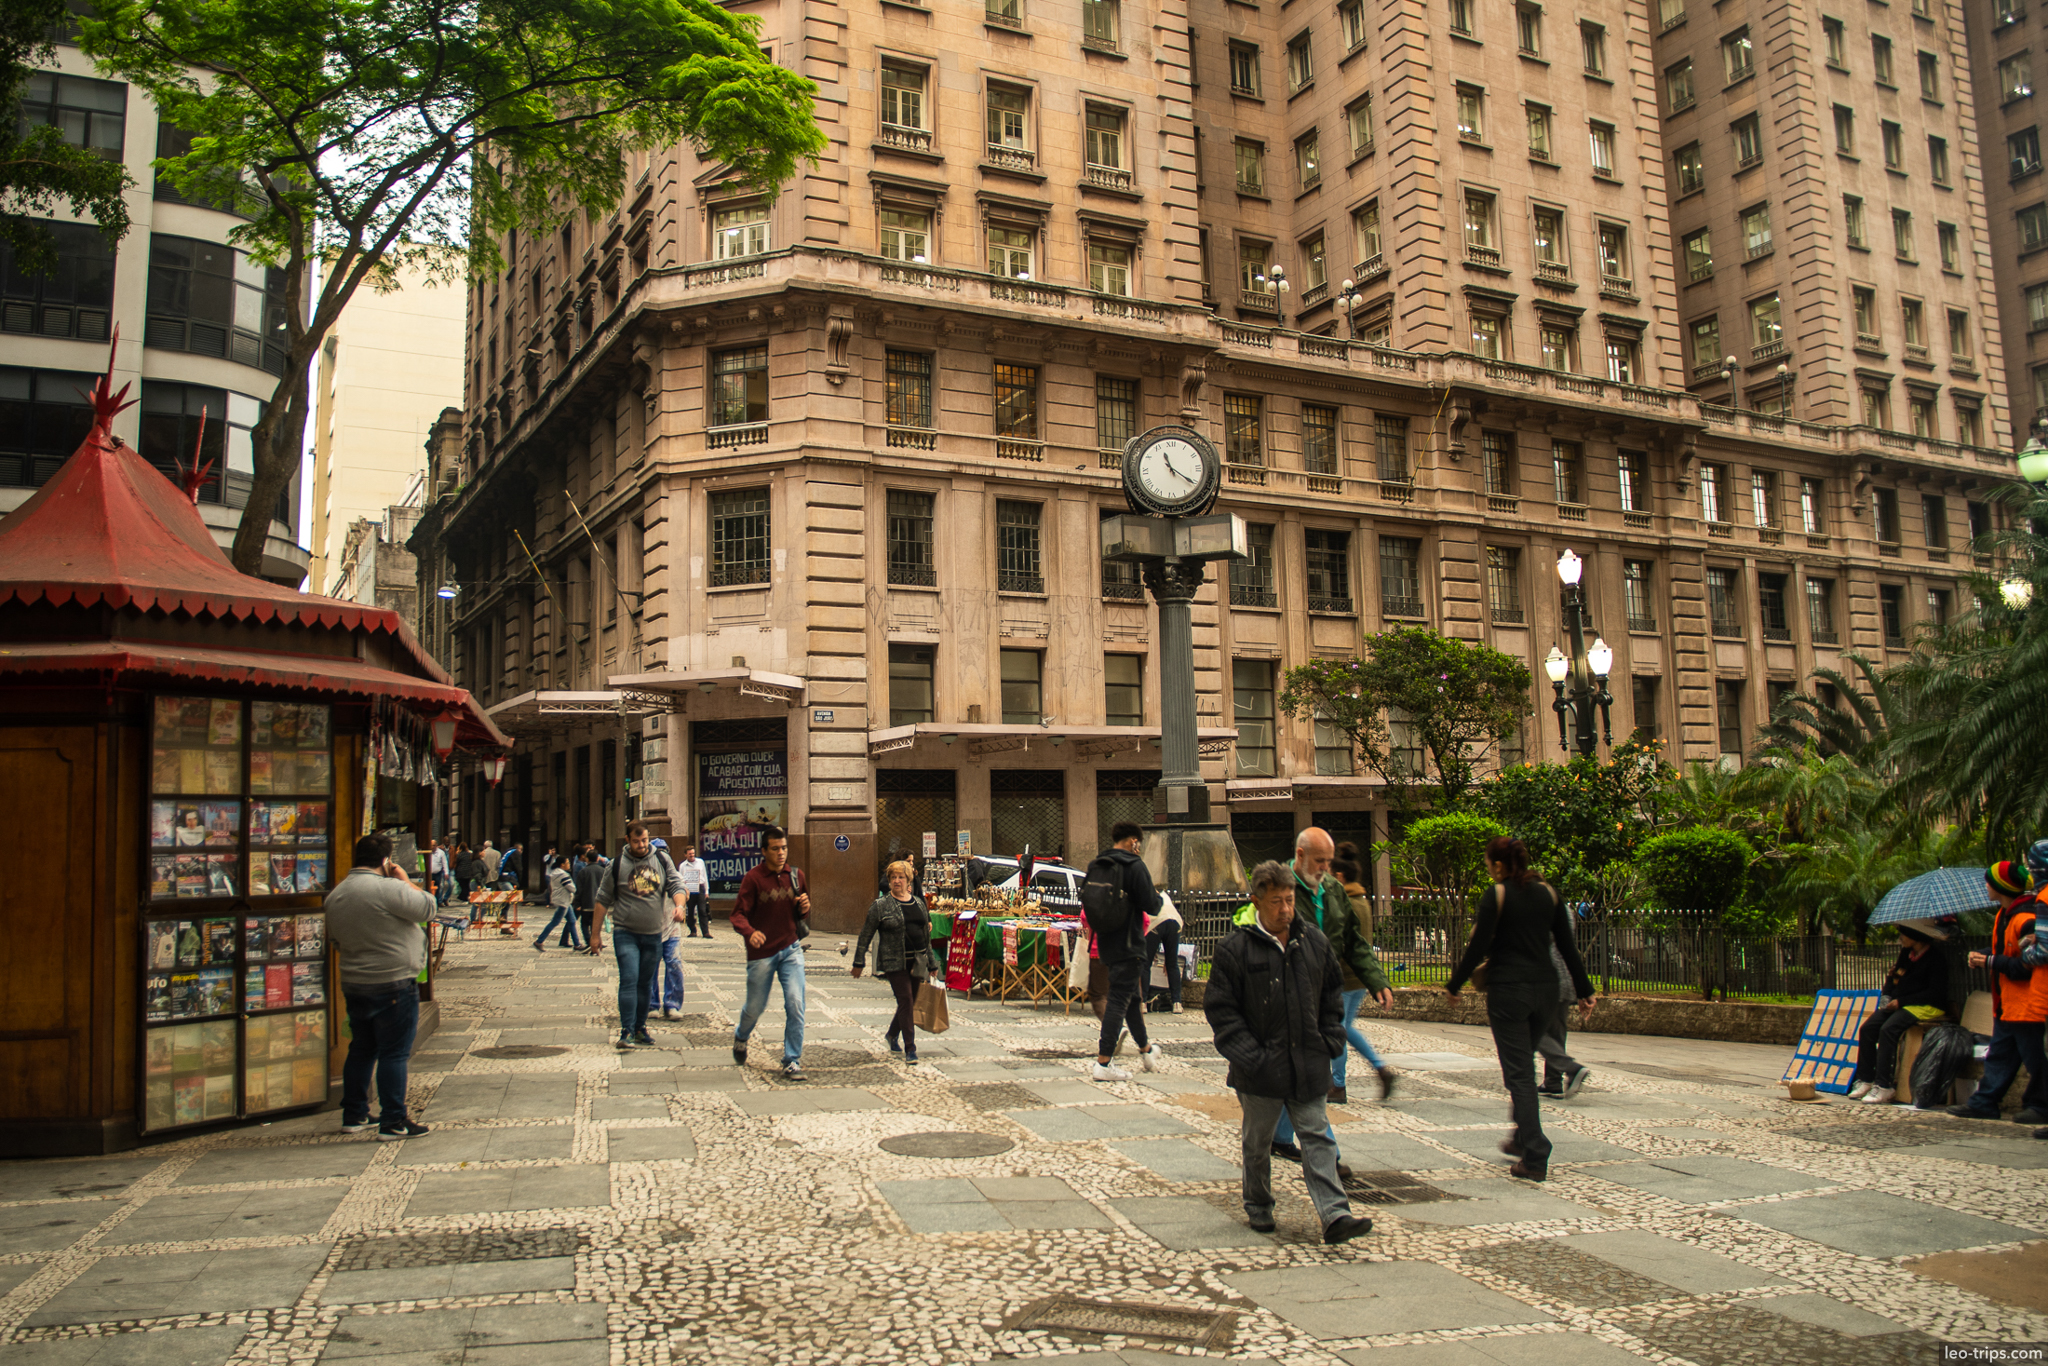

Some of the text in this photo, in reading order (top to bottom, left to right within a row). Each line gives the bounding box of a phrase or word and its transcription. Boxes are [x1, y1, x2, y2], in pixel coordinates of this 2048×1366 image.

[702, 751, 774, 766] O GOVERNO QUER
[708, 763, 781, 777] ACABAR COM SUA
[718, 776, 788, 790] APOSENTADORI
[704, 833, 737, 851] REAJA
[740, 832, 755, 848] OU
